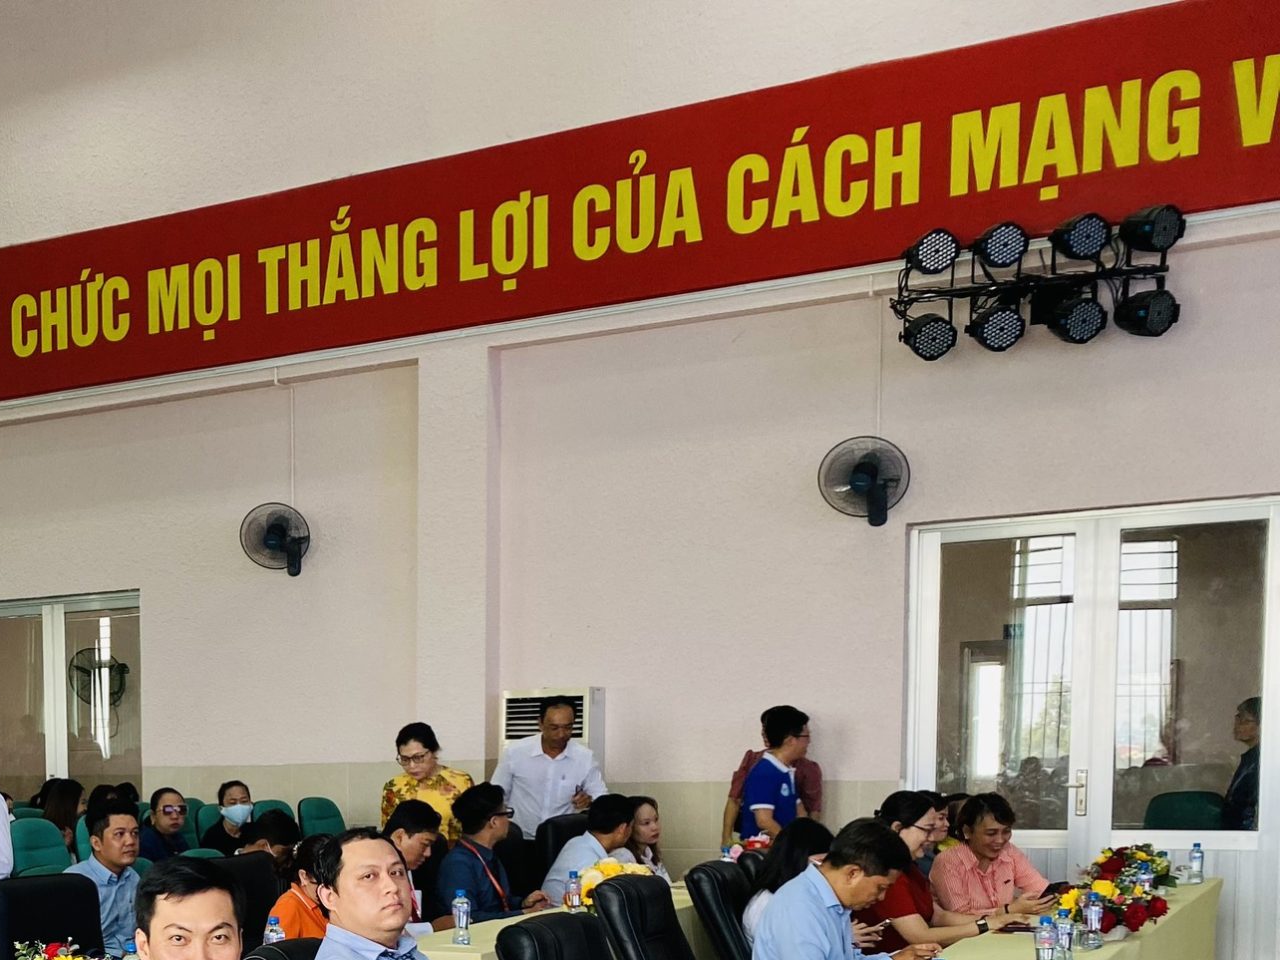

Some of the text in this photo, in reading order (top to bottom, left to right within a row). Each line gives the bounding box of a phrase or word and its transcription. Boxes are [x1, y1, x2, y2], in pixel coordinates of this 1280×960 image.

[11, 267, 130, 358] CHỨC
[148, 252, 241, 341] MỌI
[257, 205, 437, 314] THẮNG
[459, 189, 549, 292] LỢI
[573, 149, 702, 261] CỦA
[727, 122, 921, 234] CÁCH
[950, 70, 1201, 200] MẠNG
